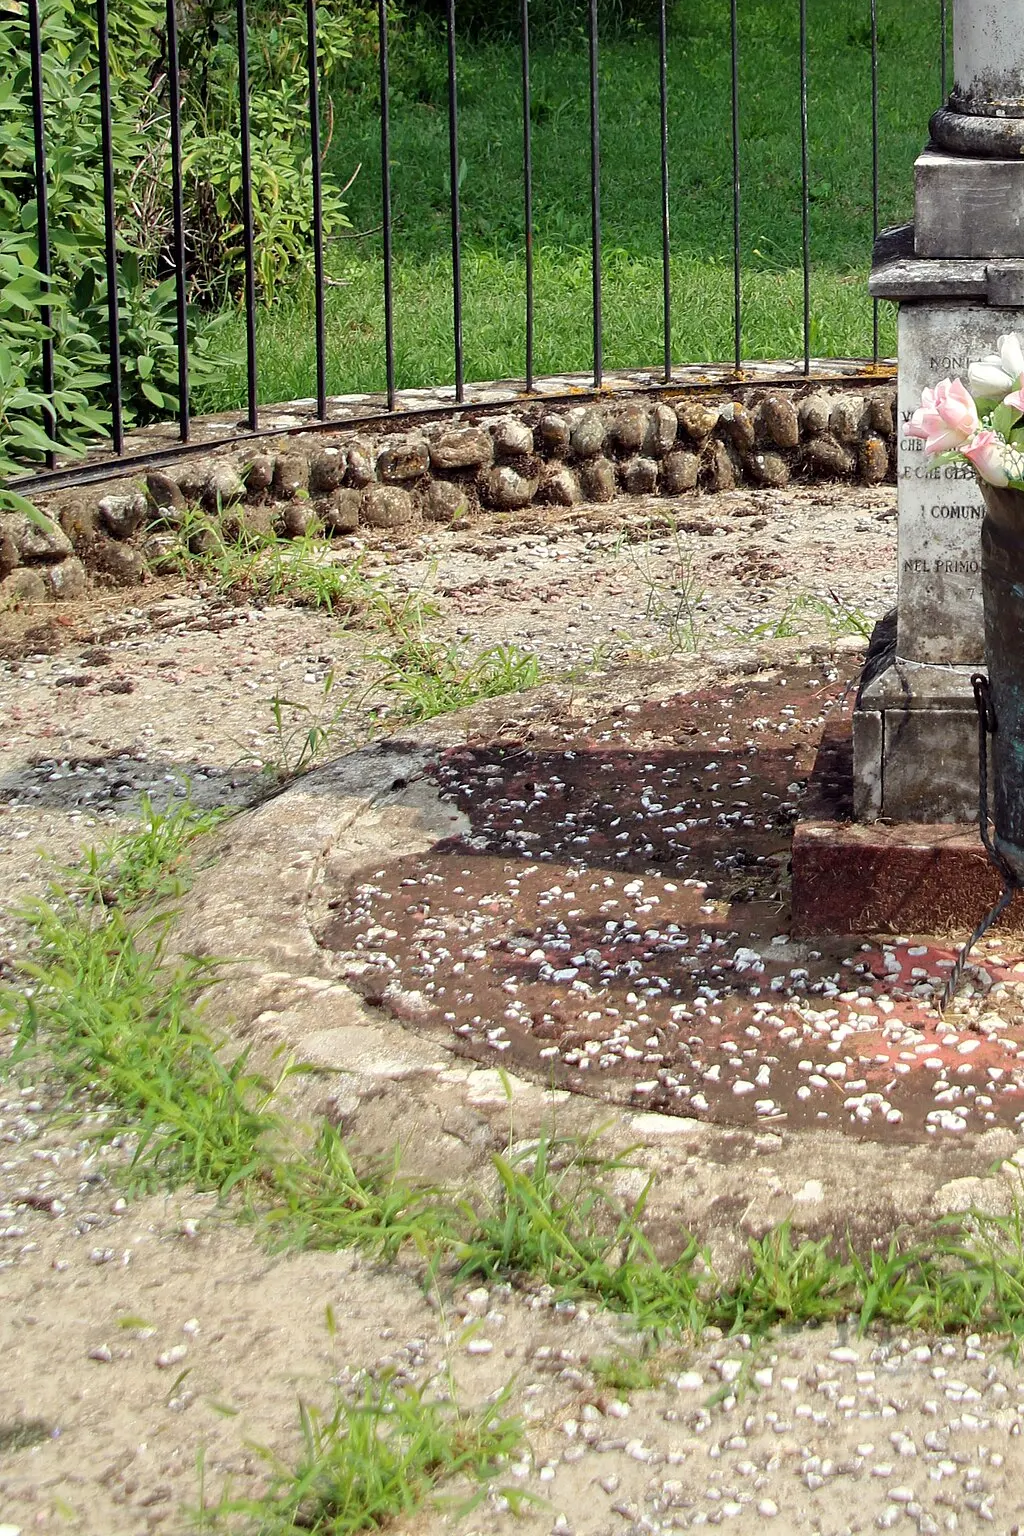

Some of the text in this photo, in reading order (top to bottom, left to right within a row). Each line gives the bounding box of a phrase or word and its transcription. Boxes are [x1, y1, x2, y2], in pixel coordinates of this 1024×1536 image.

[929, 356, 961, 369] NON
[900, 439, 923, 452] CHE
[904, 559, 979, 574] NEL PRIMO
